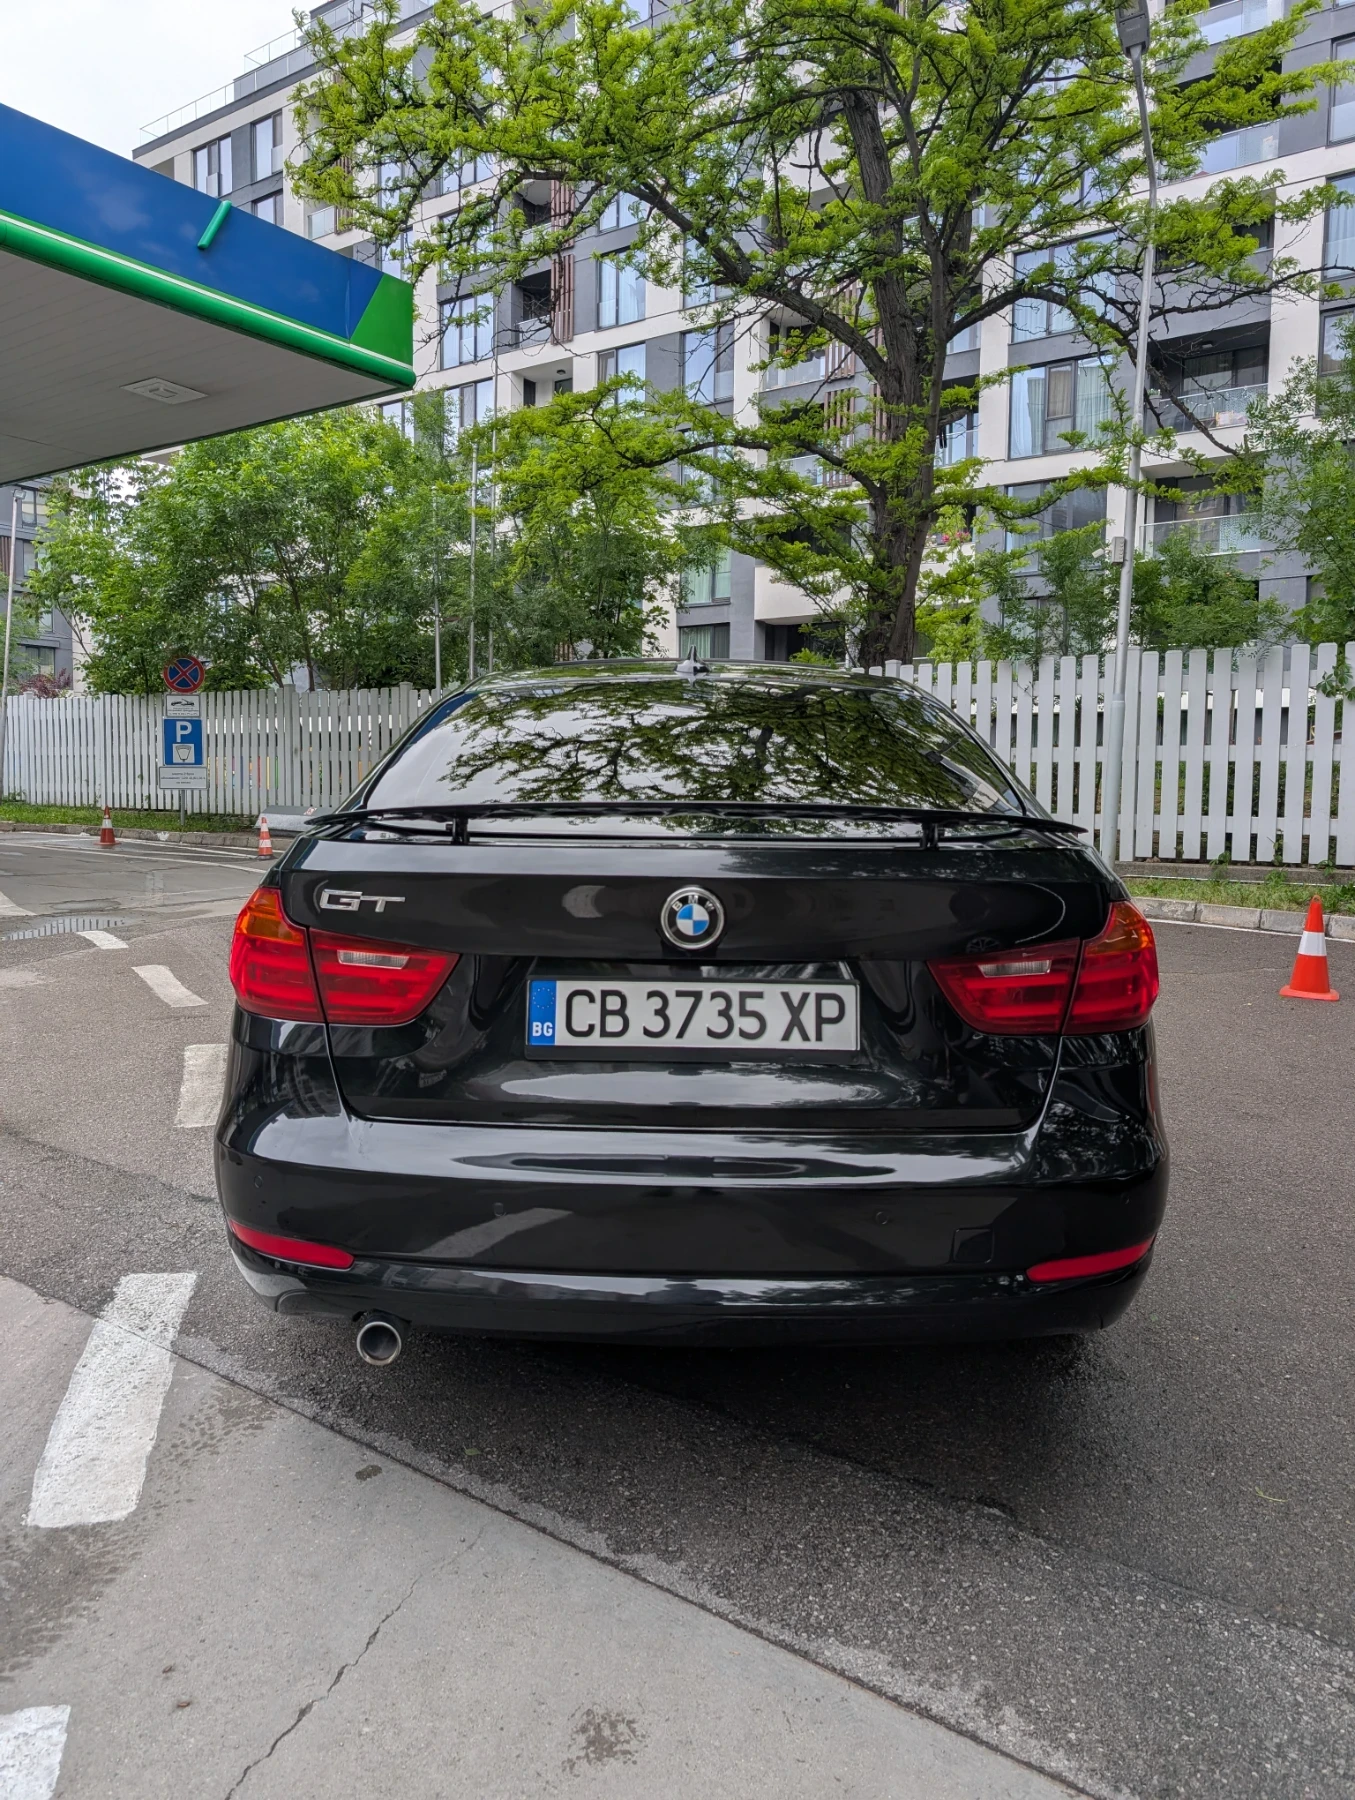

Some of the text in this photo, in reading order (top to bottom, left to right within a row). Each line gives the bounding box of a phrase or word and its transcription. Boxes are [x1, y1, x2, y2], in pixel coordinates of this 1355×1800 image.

[176, 721, 192, 743] P
[319, 889, 405, 912] GT
[671, 894, 715, 912] BMW
[565, 989, 846, 1042] CB 3735 XP
[532, 1022, 553, 1037] BG
